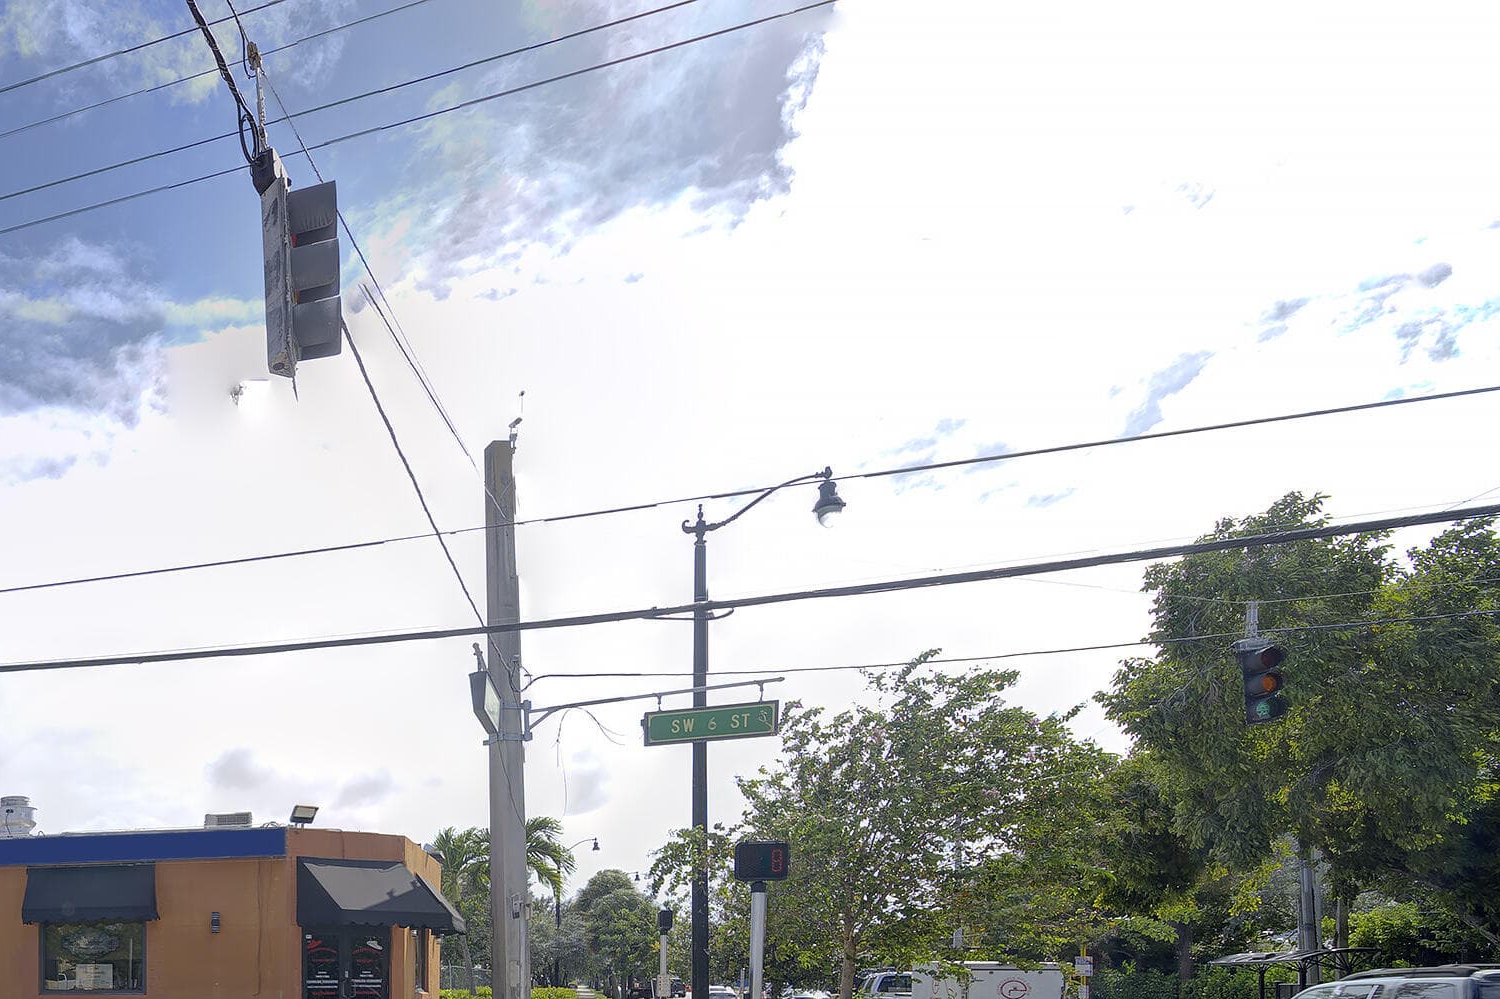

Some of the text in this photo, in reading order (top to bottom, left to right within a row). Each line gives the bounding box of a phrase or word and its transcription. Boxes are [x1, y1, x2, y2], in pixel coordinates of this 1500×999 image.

[671, 713, 750, 734] SW 6 ST
